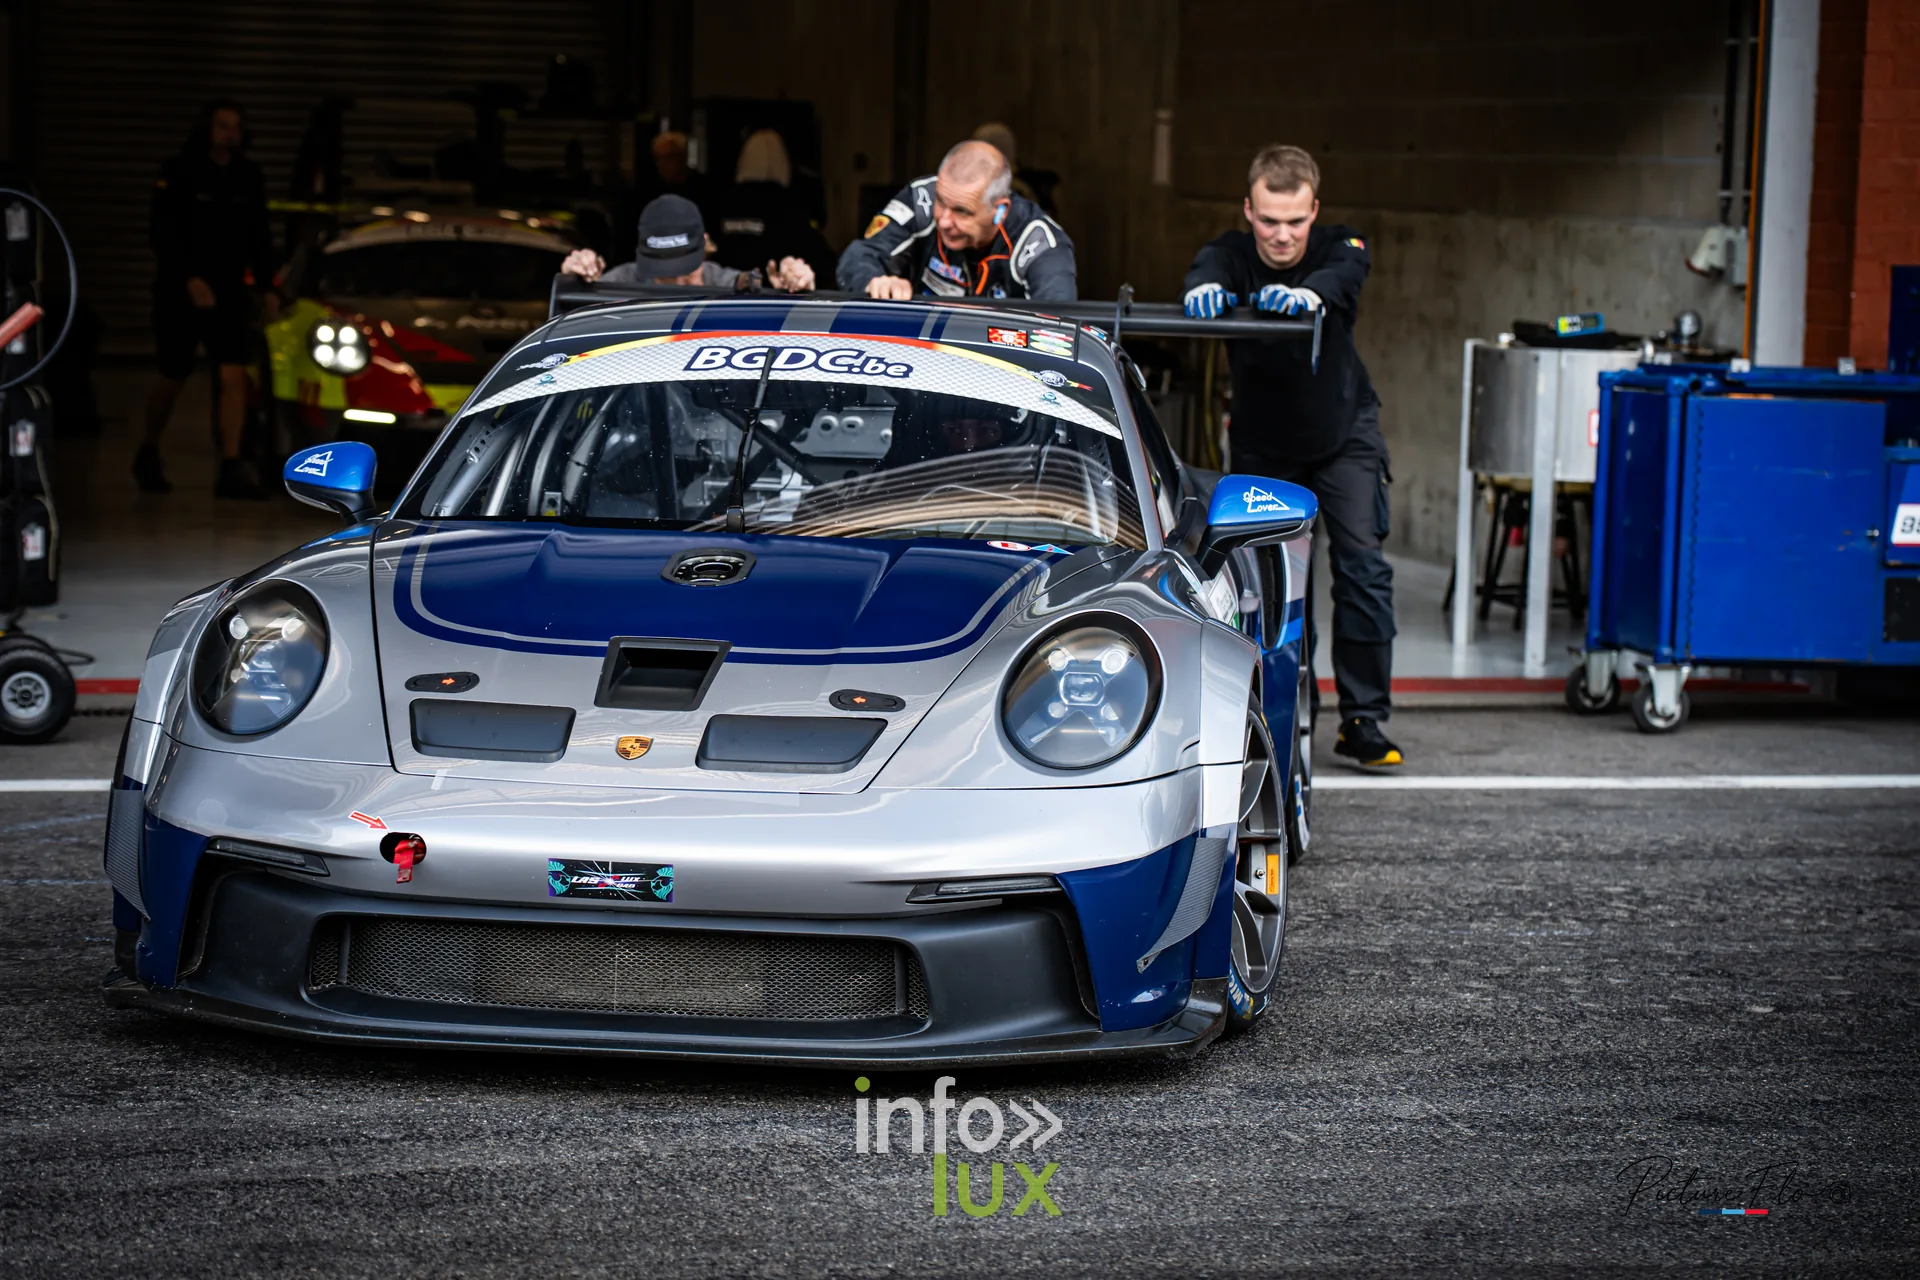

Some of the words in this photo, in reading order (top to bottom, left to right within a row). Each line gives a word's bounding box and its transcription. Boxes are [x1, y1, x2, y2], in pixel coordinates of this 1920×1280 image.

[685, 346, 912, 377] BGDC.be
[1242, 491, 1273, 503] Speed
[1247, 503, 1279, 513] Lover
